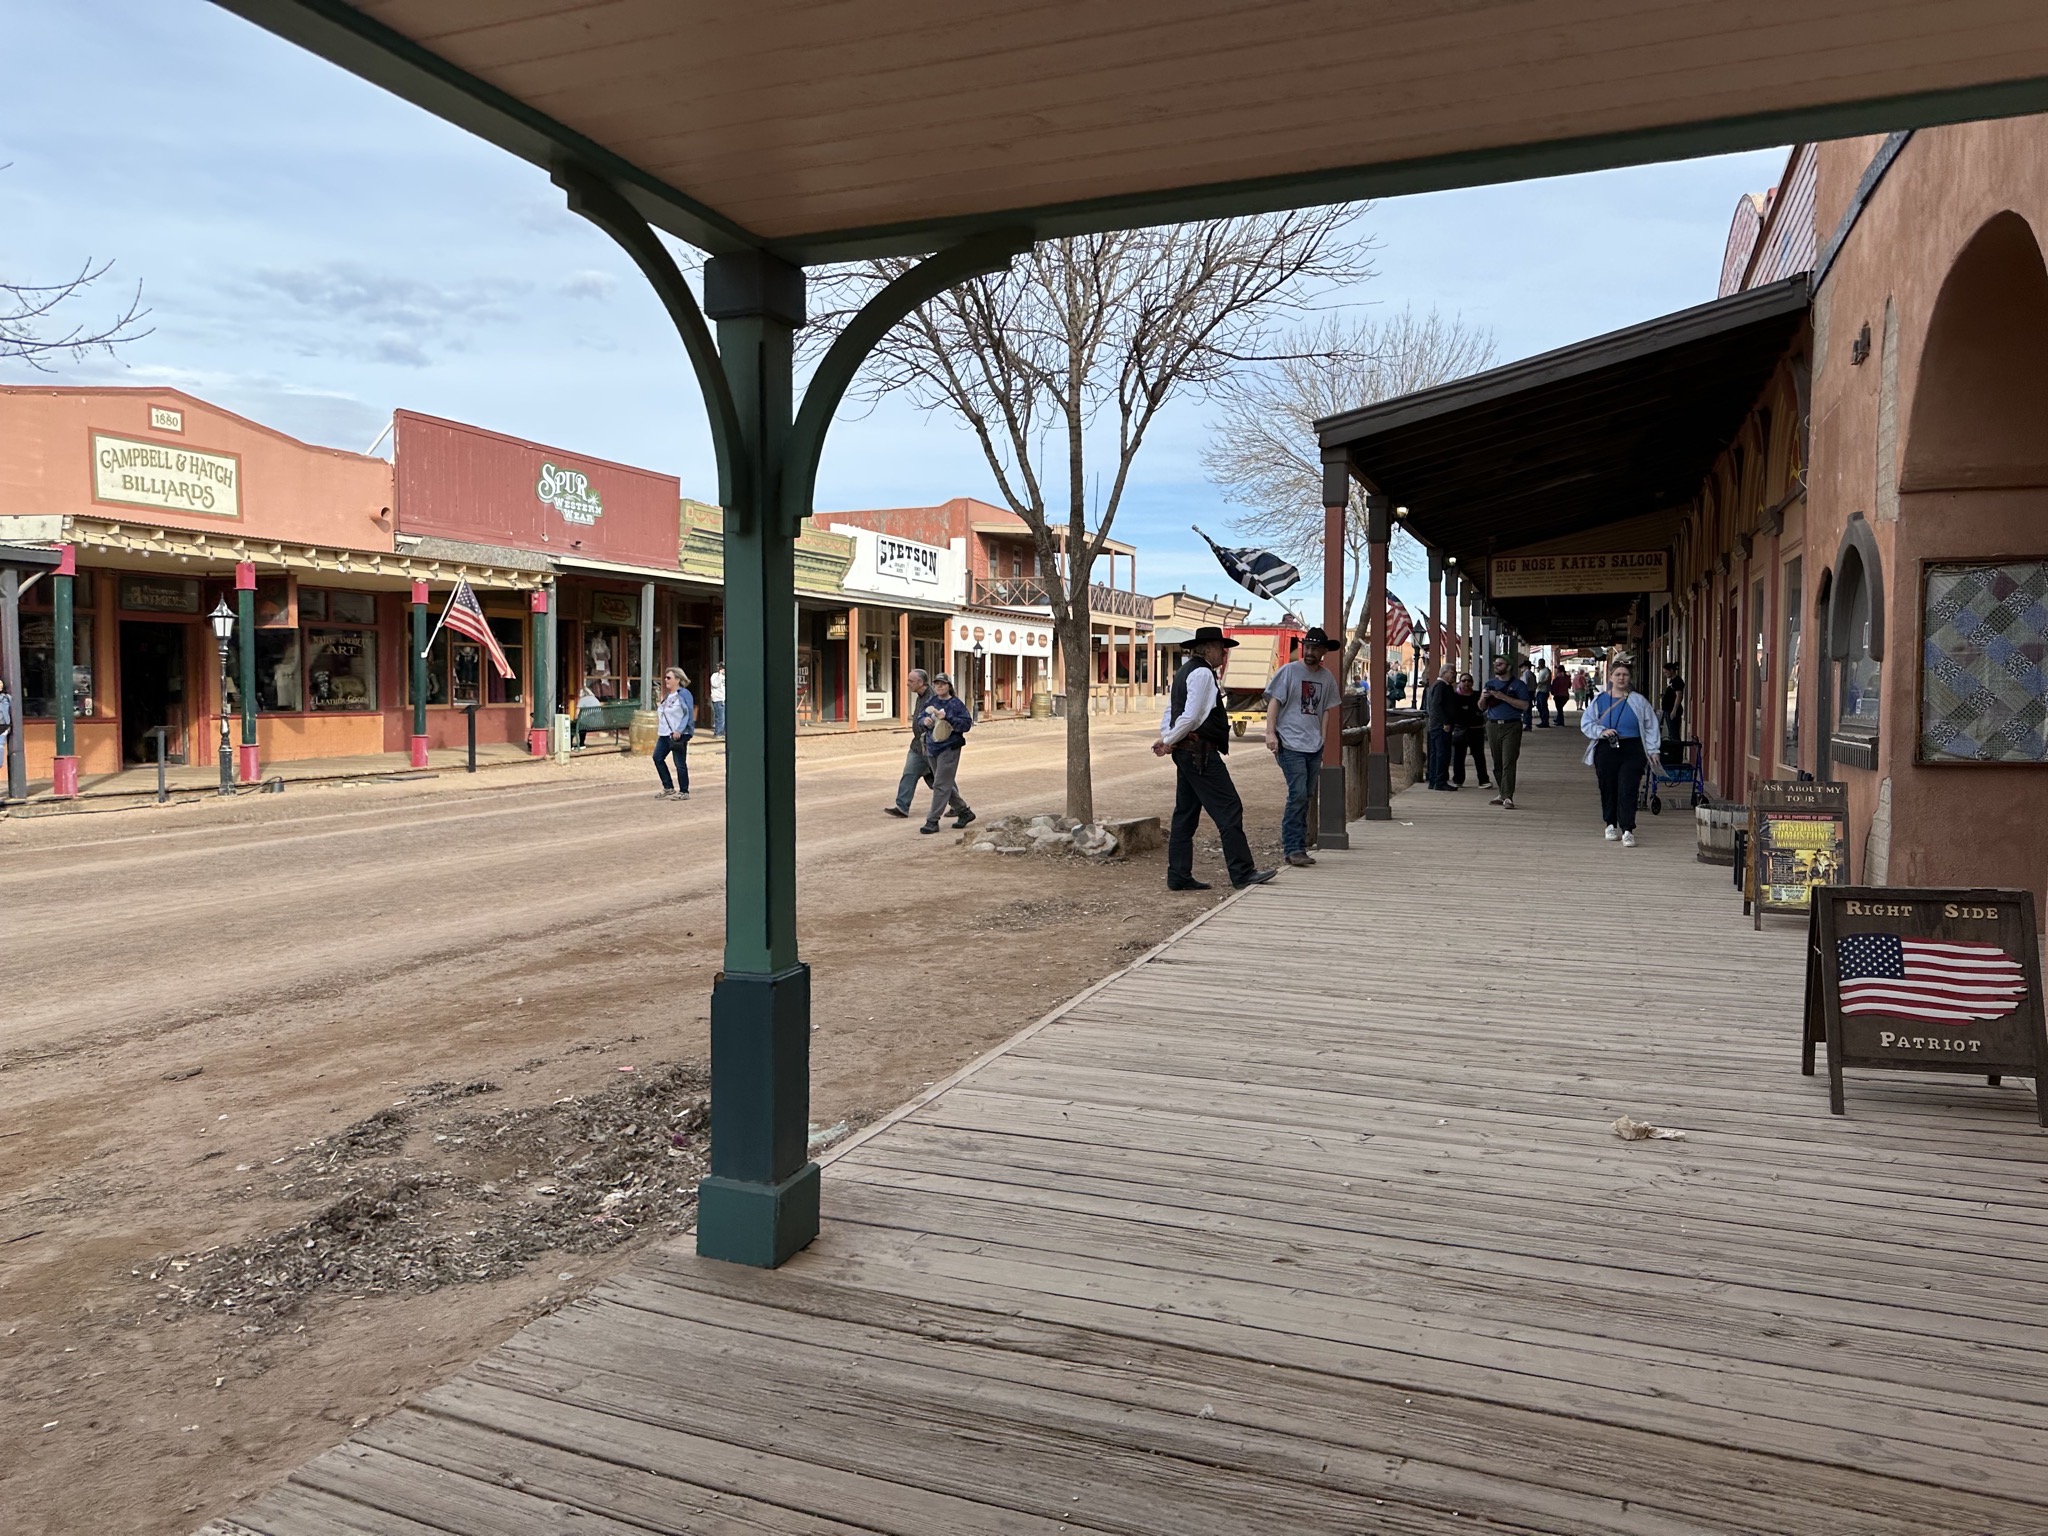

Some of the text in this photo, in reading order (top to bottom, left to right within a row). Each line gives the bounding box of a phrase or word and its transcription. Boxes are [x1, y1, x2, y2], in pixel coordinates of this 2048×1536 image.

[154, 413, 179, 428] 1880
[100, 448, 234, 489] CAMPBELL & HATCH
[122, 474, 215, 510] BILLIARDS
[880, 539, 937, 577] STETSON
[1495, 553, 1664, 573] BIG NOSE KATE'S SALOON
[327, 645, 357, 656] ART
[1763, 784, 1841, 794] ASK ABOUT MY
